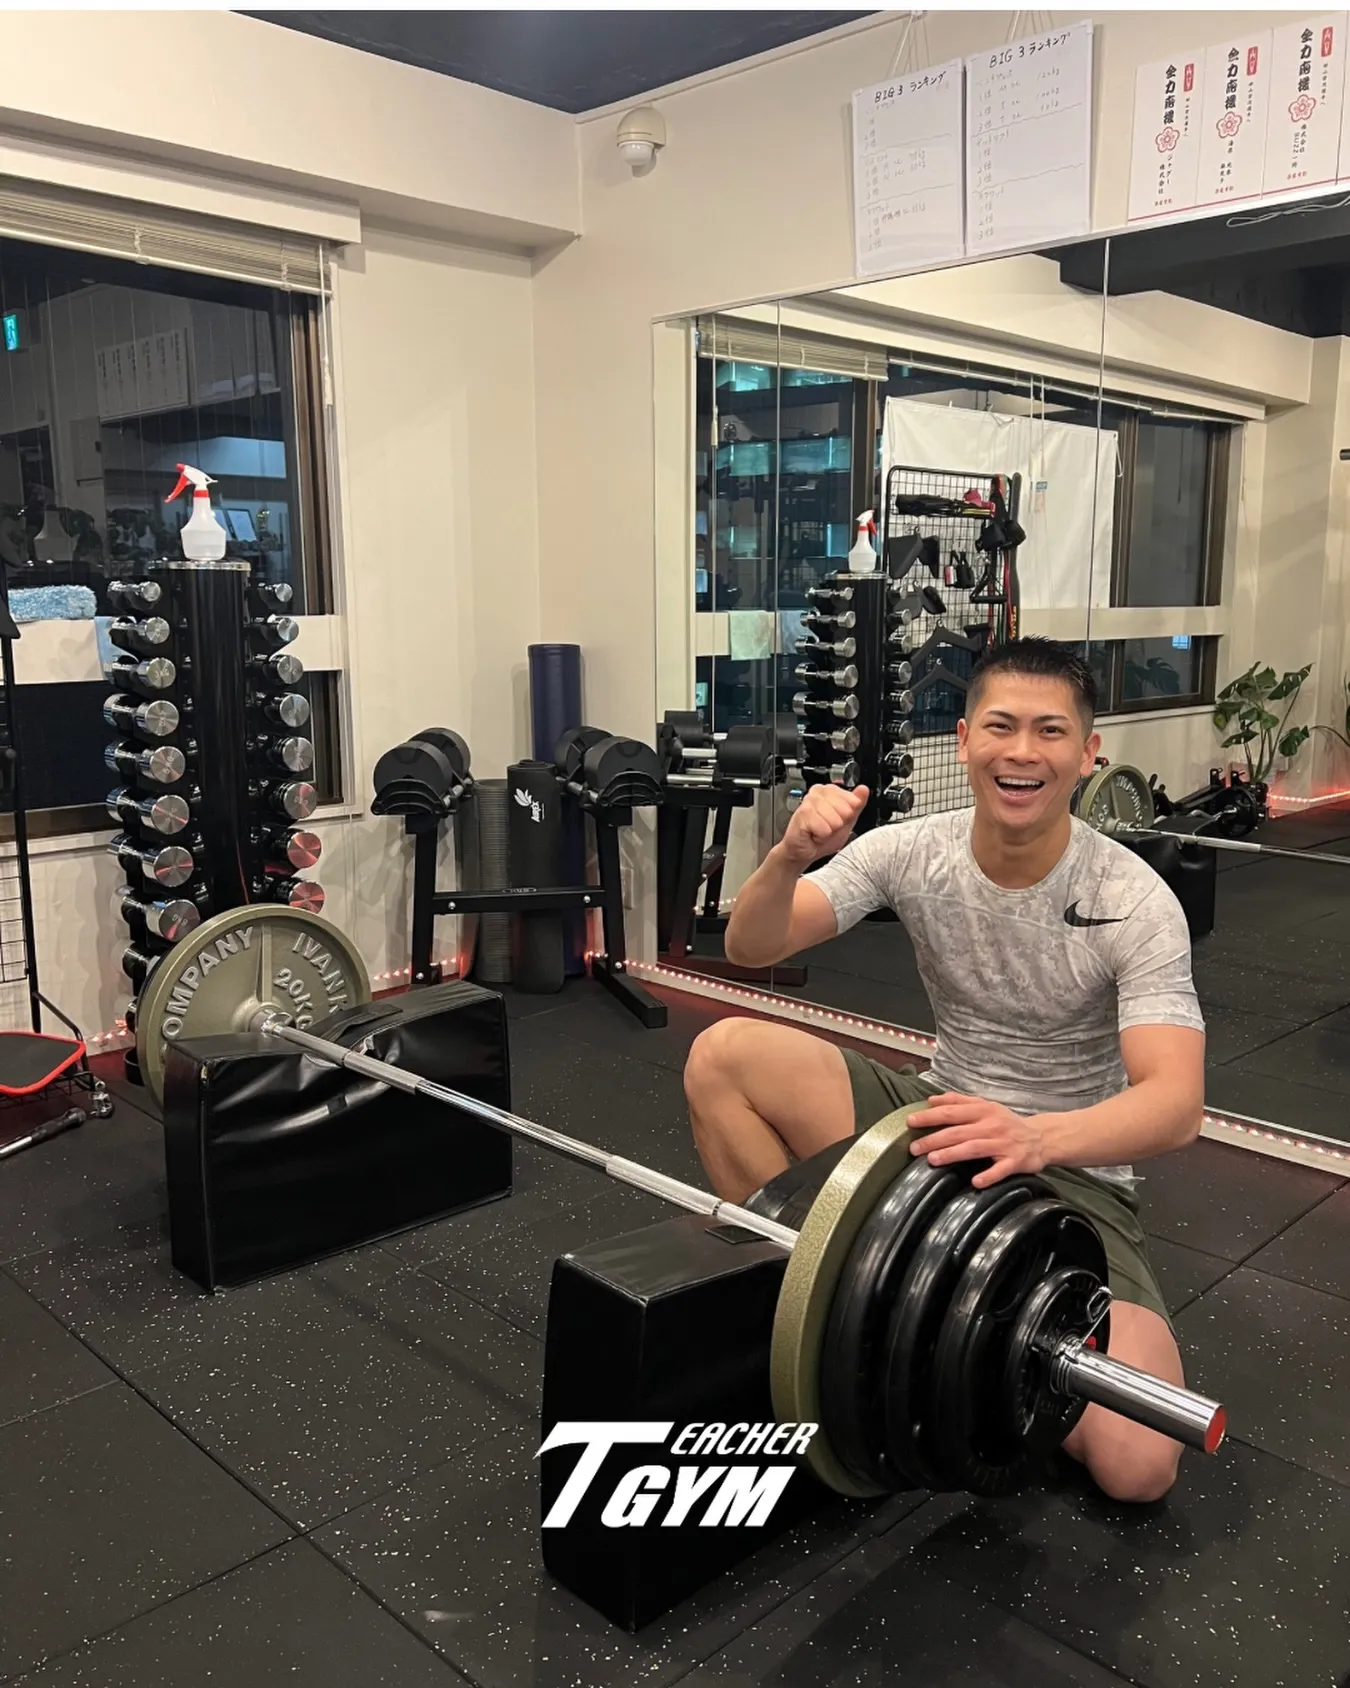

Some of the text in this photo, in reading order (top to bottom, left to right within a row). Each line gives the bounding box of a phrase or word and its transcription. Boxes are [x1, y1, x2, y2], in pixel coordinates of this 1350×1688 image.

[988, 32, 1071, 68] BIG 3 ランキング
[874, 71, 947, 103] BIG 3 ランキング
[161, 925, 254, 1040] OMPANY
[291, 932, 349, 1014] IVANK
